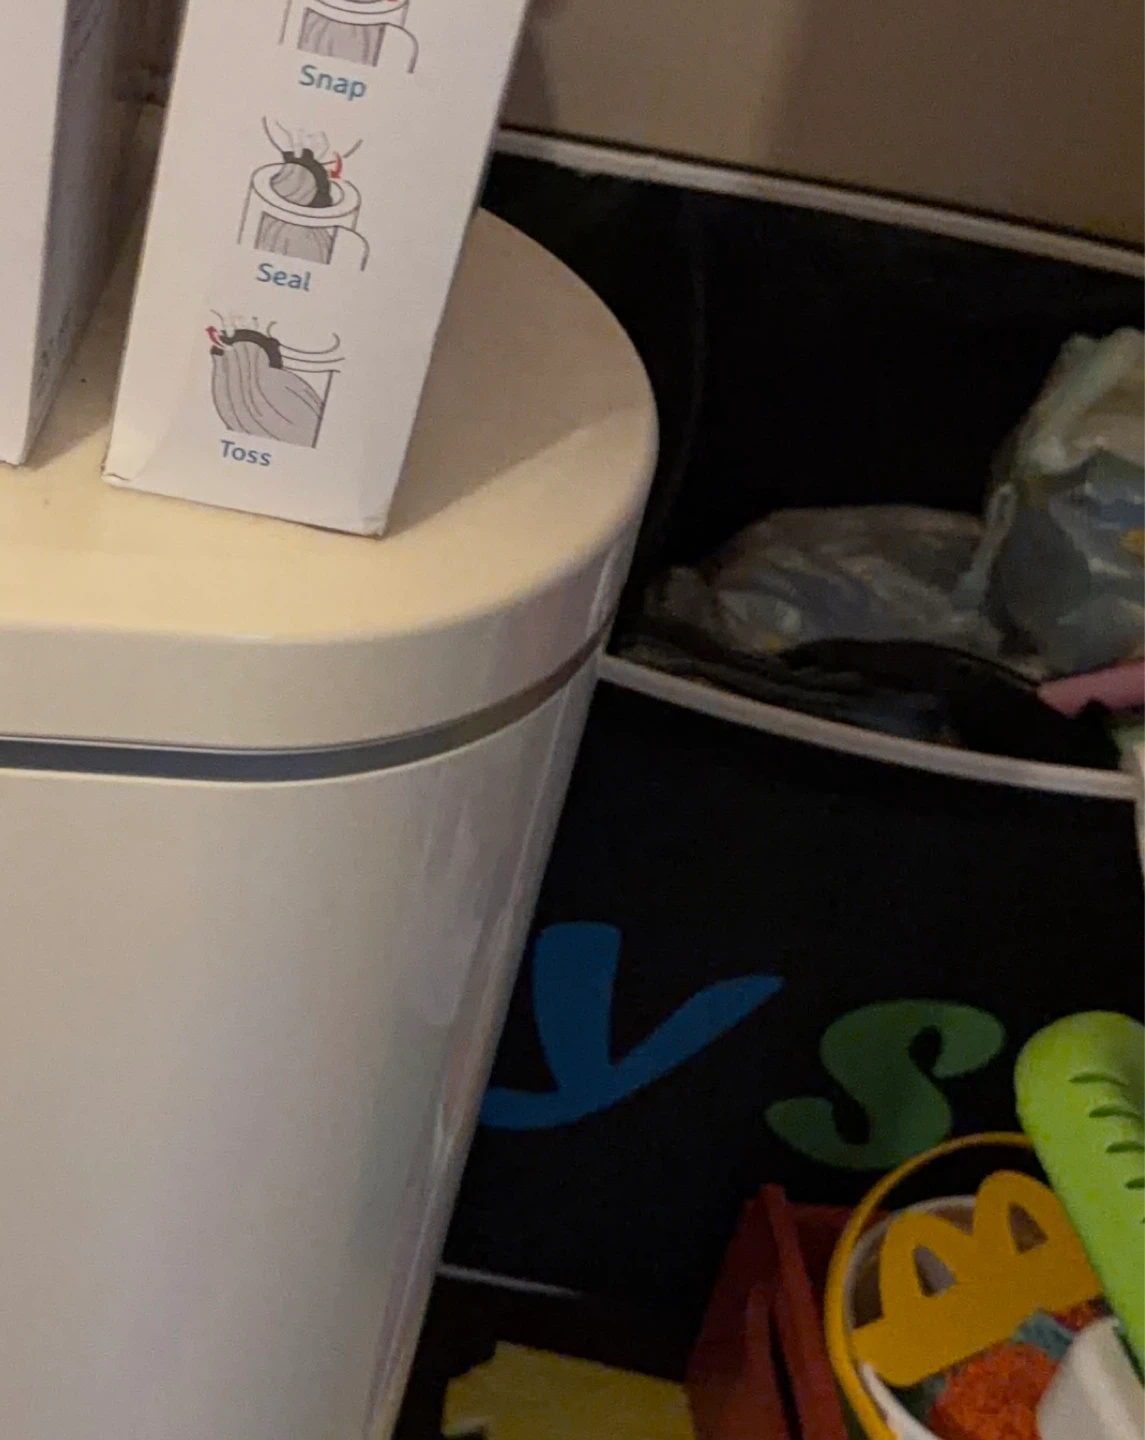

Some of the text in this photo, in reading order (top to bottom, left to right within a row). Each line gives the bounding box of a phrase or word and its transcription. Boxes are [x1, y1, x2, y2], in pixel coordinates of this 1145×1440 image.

[298, 63, 367, 101] Snap
[255, 262, 312, 292] Seal
[220, 439, 272, 467] Toss
